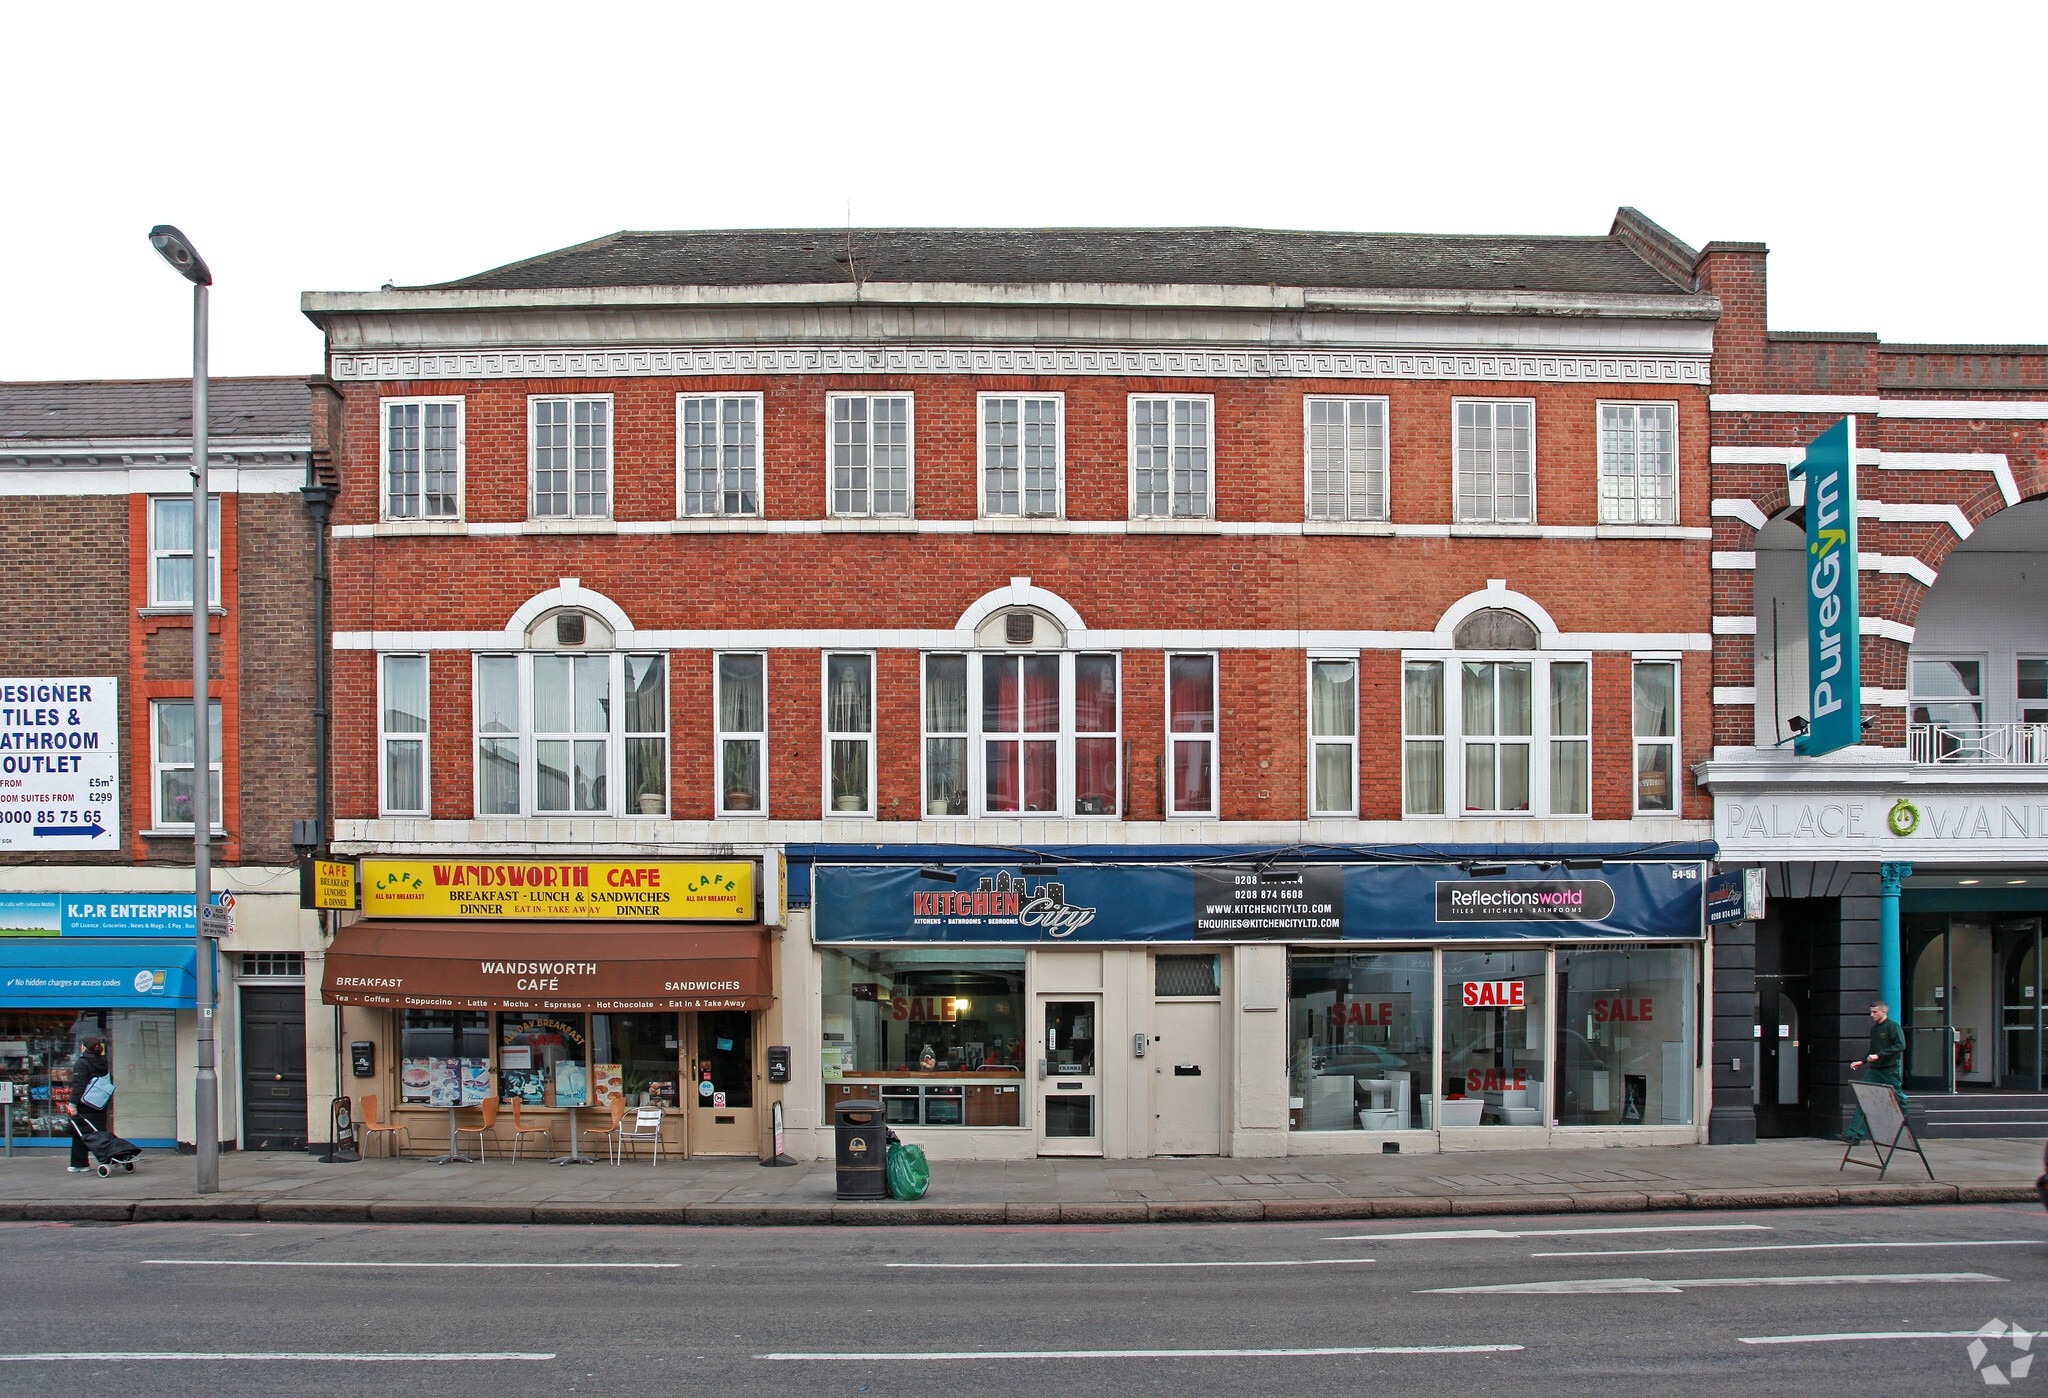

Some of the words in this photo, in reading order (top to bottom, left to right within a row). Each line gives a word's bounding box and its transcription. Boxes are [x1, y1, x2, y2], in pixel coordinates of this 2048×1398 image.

[1811, 470, 1847, 719] PureGym
[0, 685, 92, 703] ESIGNER
[3, 708, 60, 726] TILES
[67, 708, 81, 726] &
[0, 732, 98, 749] ATHROOM
[3, 756, 82, 773] OUTLET
[21, 794, 50, 802] SUITES
[52, 794, 75, 802] FROM
[89, 792, 113, 802] £299
[37, 810, 55, 823] 85
[60, 810, 78, 823] 75
[83, 810, 102, 823] 65
[1726, 803, 1865, 839] PALACE
[322, 864, 347, 877] CAFE
[433, 865, 589, 887] WANDSWORTH
[607, 868, 661, 888] CAFE
[1672, 870, 1697, 879] 54-58
[320, 877, 349, 888] BREAKFAST
[376, 872, 423, 890] CAFE
[688, 874, 735, 893] CAFE
[1235, 875, 1257, 885] 0208
[324, 888, 347, 897] LUNCHES
[449, 891, 520, 902] BREAKFAST
[530, 891, 570, 902] LUNCH
[575, 891, 585, 902] &
[590, 892, 670, 903] SANDWICHES
[1235, 890, 1257, 899] 0208
[1260, 890, 1278, 899] 874
[1280, 890, 1303, 899] 6608
[1451, 889, 1583, 906] Reflectionsworld
[323, 898, 328, 906] &
[329, 898, 348, 907] DINNER
[1206, 904, 1332, 914] WWW.KITCHENCITYLTD.COM
[68, 904, 107, 918] K.P.R
[460, 904, 503, 914] DINNER
[514, 905, 531, 913] EAT
[533, 905, 542, 913] IN
[548, 905, 570, 914] TAKE
[572, 905, 601, 914] AWAY
[616, 905, 660, 916] DINNER
[735, 906, 744, 914] 62
[914, 891, 1019, 916] KITCHEN
[1019, 897, 1096, 938] City
[150, 922, 164, 930] Mags
[172, 922, 182, 930] Pay
[1198, 918, 1340, 929] ENQUIRIES@KITCHENCITYLTD.COM
[481, 962, 597, 975] WANDSWORTH
[15, 978, 24, 987] No
[25, 978, 47, 987] hidden
[48, 979, 72, 988] charges
[103, 979, 121, 987] codes
[336, 976, 403, 988] BREAKFAST
[517, 976, 559, 991] CAFÉ
[664, 981, 740, 991] SANDWICHES
[1463, 982, 1523, 1006] SALE
[335, 994, 349, 1002] Tea
[364, 995, 390, 1003] Coffee
[405, 997, 453, 1006] Cappuccino
[467, 999, 488, 1007] Latte
[503, 1000, 529, 1008] Mocha
[544, 1001, 582, 1009] Espresso
[613, 1000, 654, 1008] Chocolate
[723, 1000, 746, 1008] Away
[892, 997, 956, 1021] SALE
[1332, 1002, 1393, 1027] SALE
[1594, 998, 1653, 1022] SALE
[504, 1030, 518, 1045] ALL
[516, 1019, 534, 1033] DAY
[537, 1018, 586, 1046] BREAKFAST
[528, 1033, 563, 1046] CAFE
[1467, 1068, 1527, 1092] SALE
